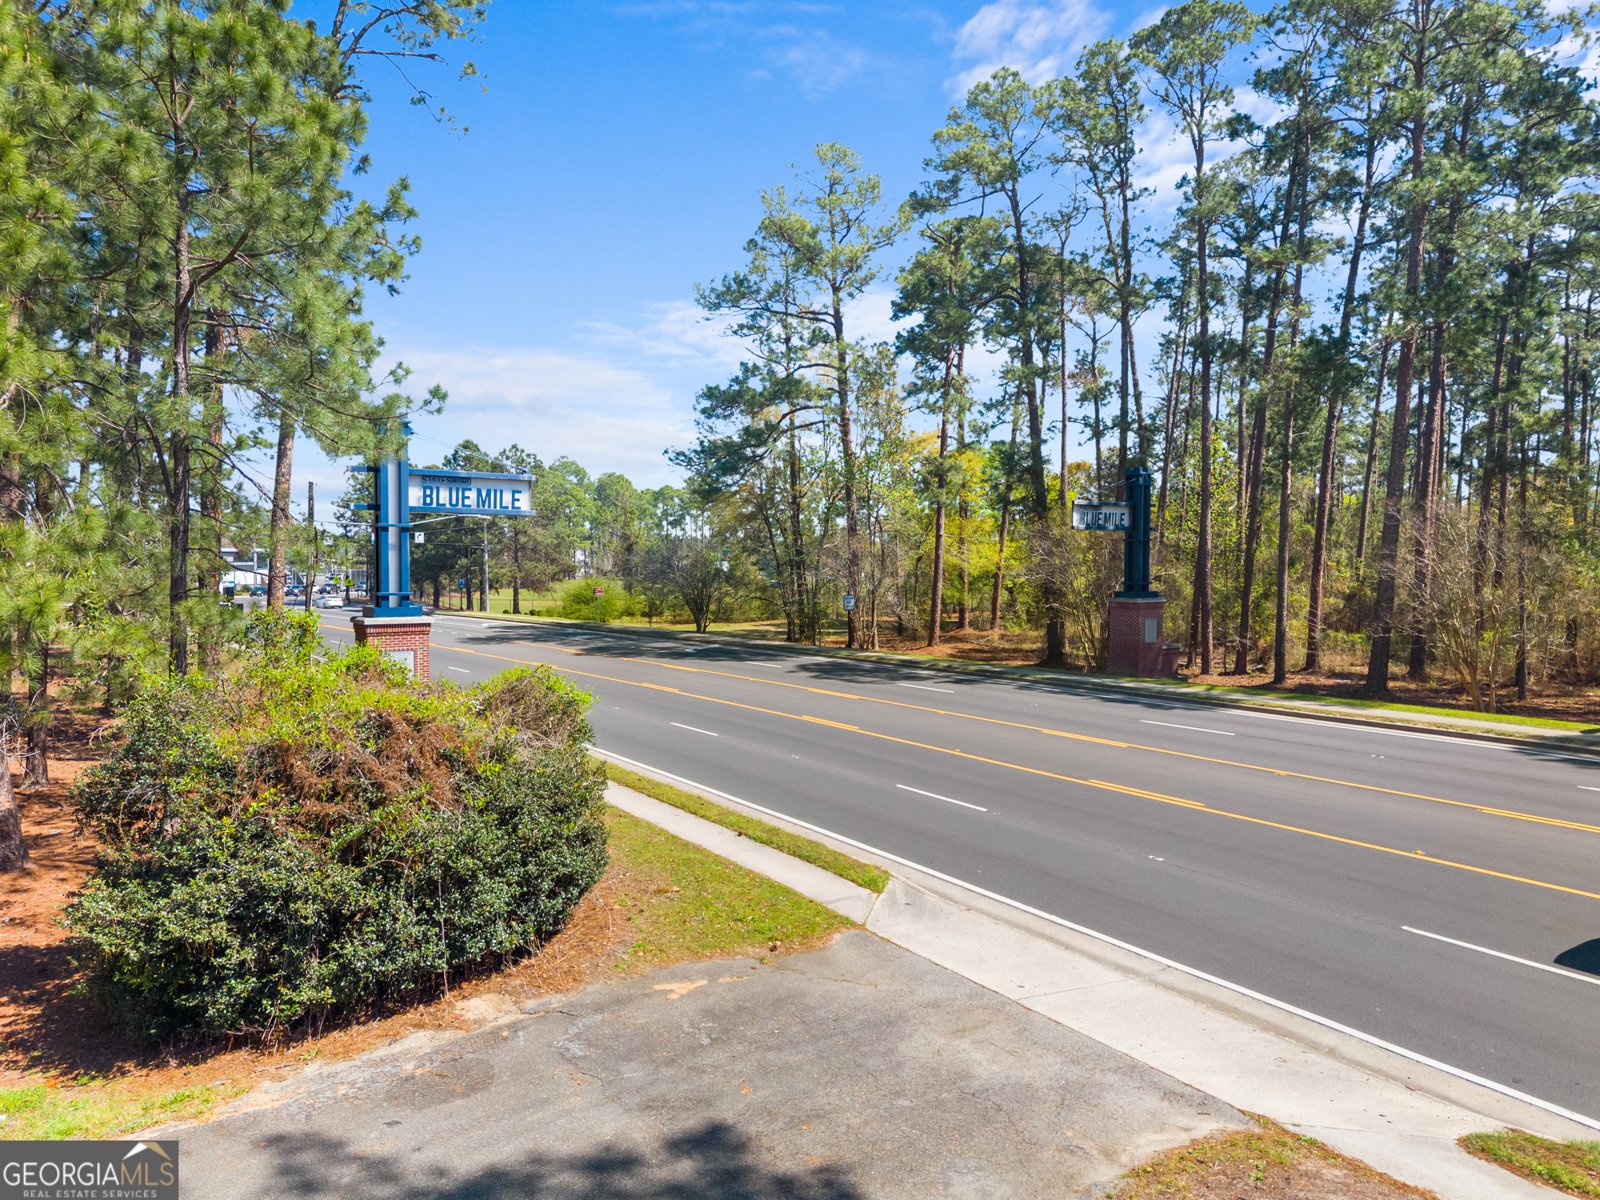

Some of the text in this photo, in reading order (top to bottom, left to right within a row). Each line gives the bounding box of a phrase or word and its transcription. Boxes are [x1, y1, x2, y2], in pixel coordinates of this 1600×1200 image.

[422, 485, 522, 510] BLUE MILE
[1104, 512, 1126, 527] MILE
